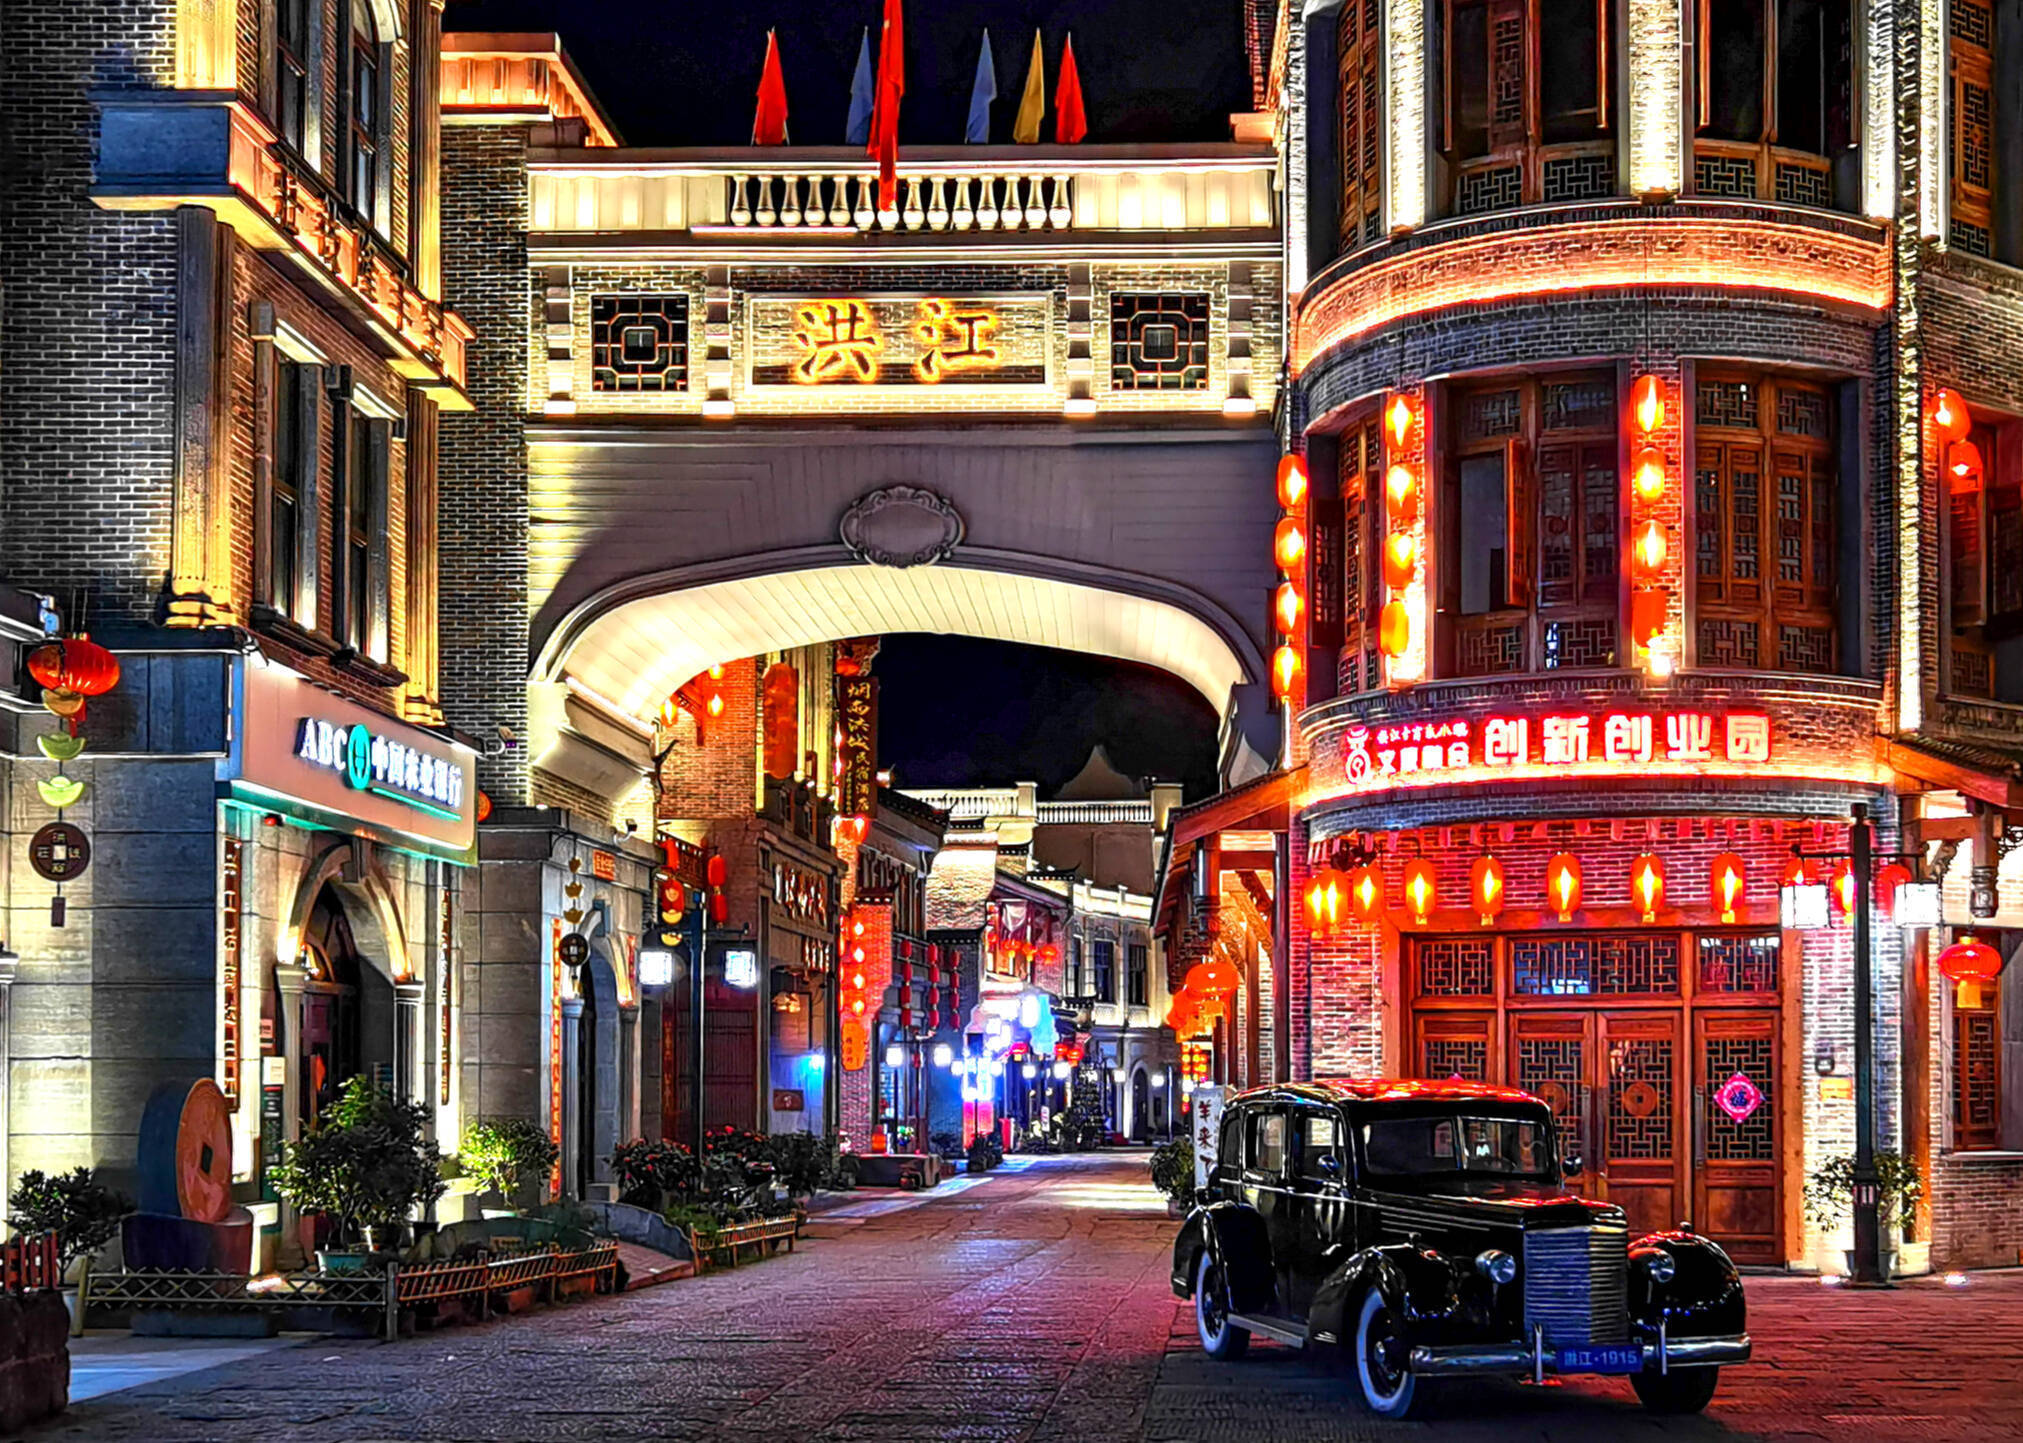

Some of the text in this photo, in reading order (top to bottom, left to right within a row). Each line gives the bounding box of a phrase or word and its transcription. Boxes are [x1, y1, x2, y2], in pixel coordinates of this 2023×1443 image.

[795, 299, 998, 377] 洪江
[299, 717, 348, 771] ABC
[1484, 713, 1770, 764] 创新创业园
[371, 735, 463, 808] 中国农业银行
